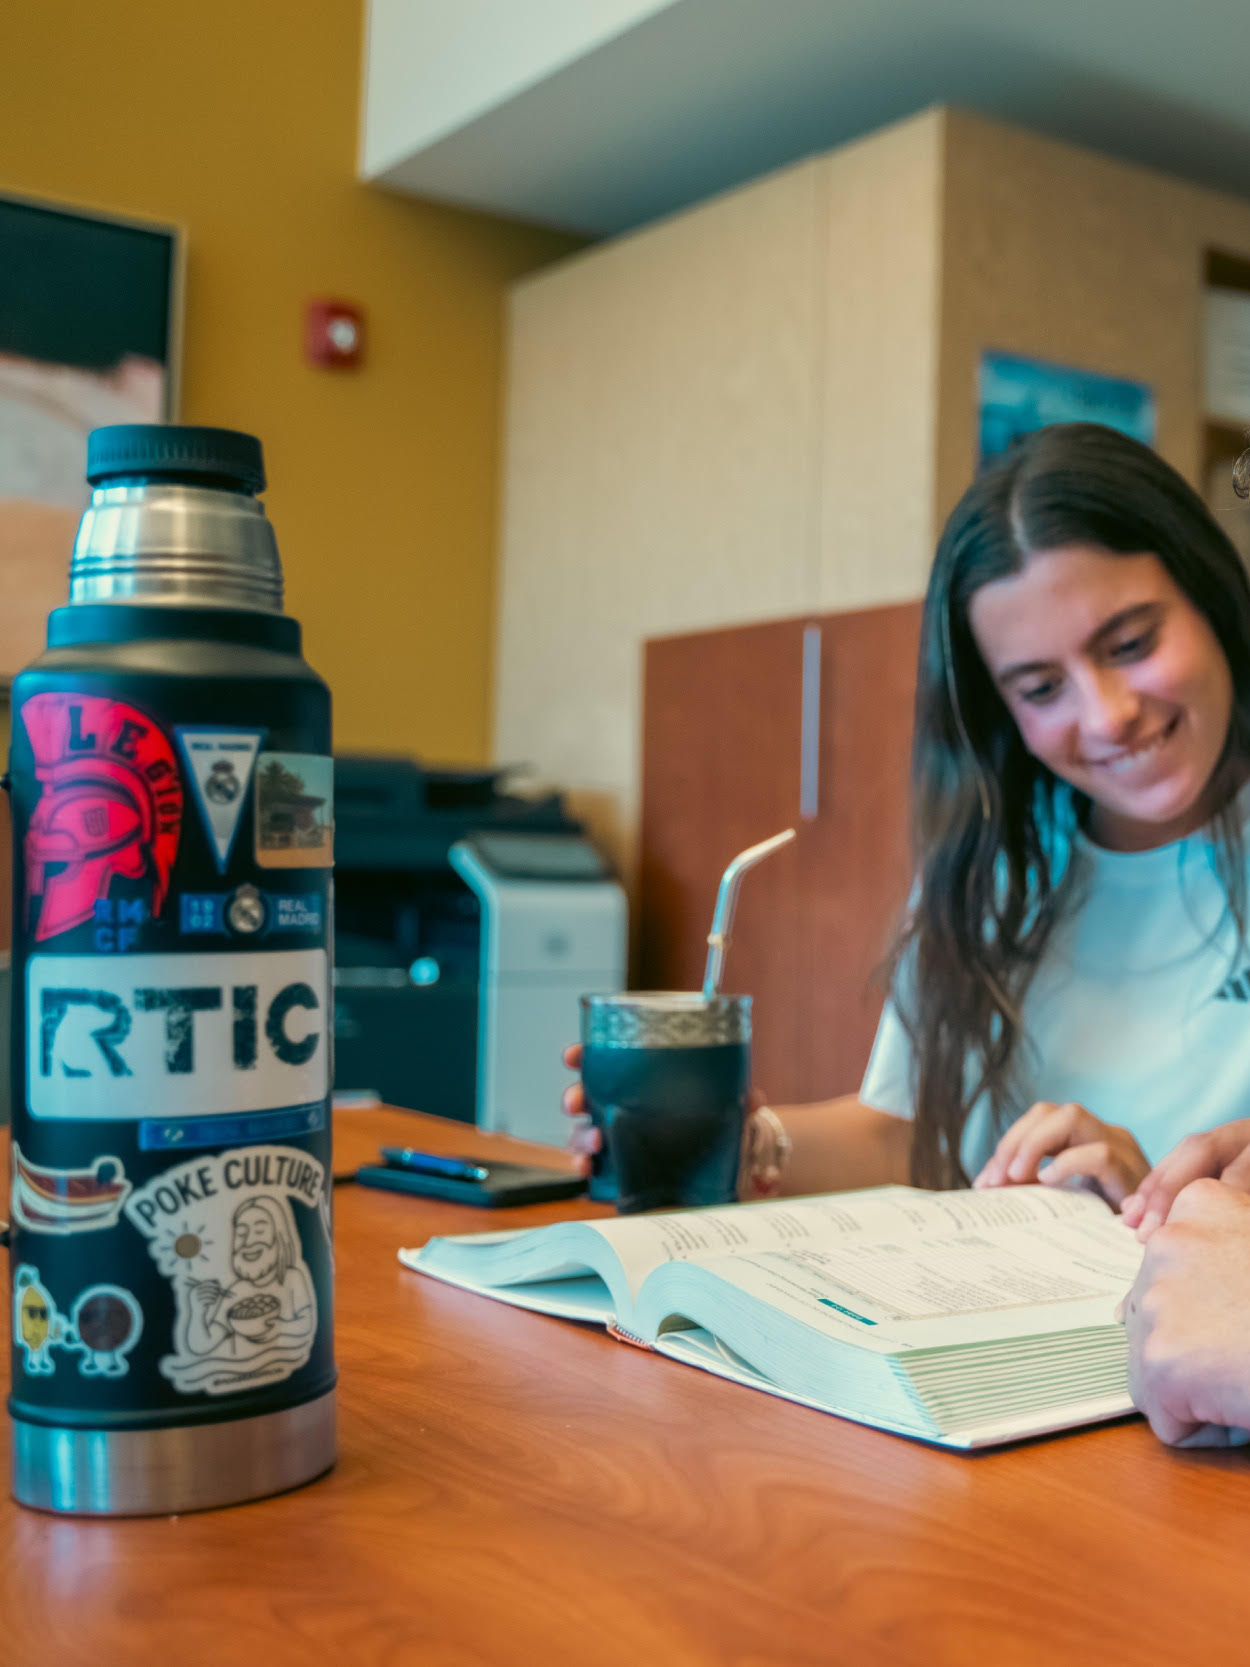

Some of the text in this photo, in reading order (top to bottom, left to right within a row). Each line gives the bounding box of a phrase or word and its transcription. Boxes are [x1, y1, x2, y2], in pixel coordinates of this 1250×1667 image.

[68, 705, 180, 834] LEGION
[278, 899, 308, 912] REAL
[39, 982, 320, 1077] RTIC
[135, 1154, 320, 1228] POKE CULTURE
